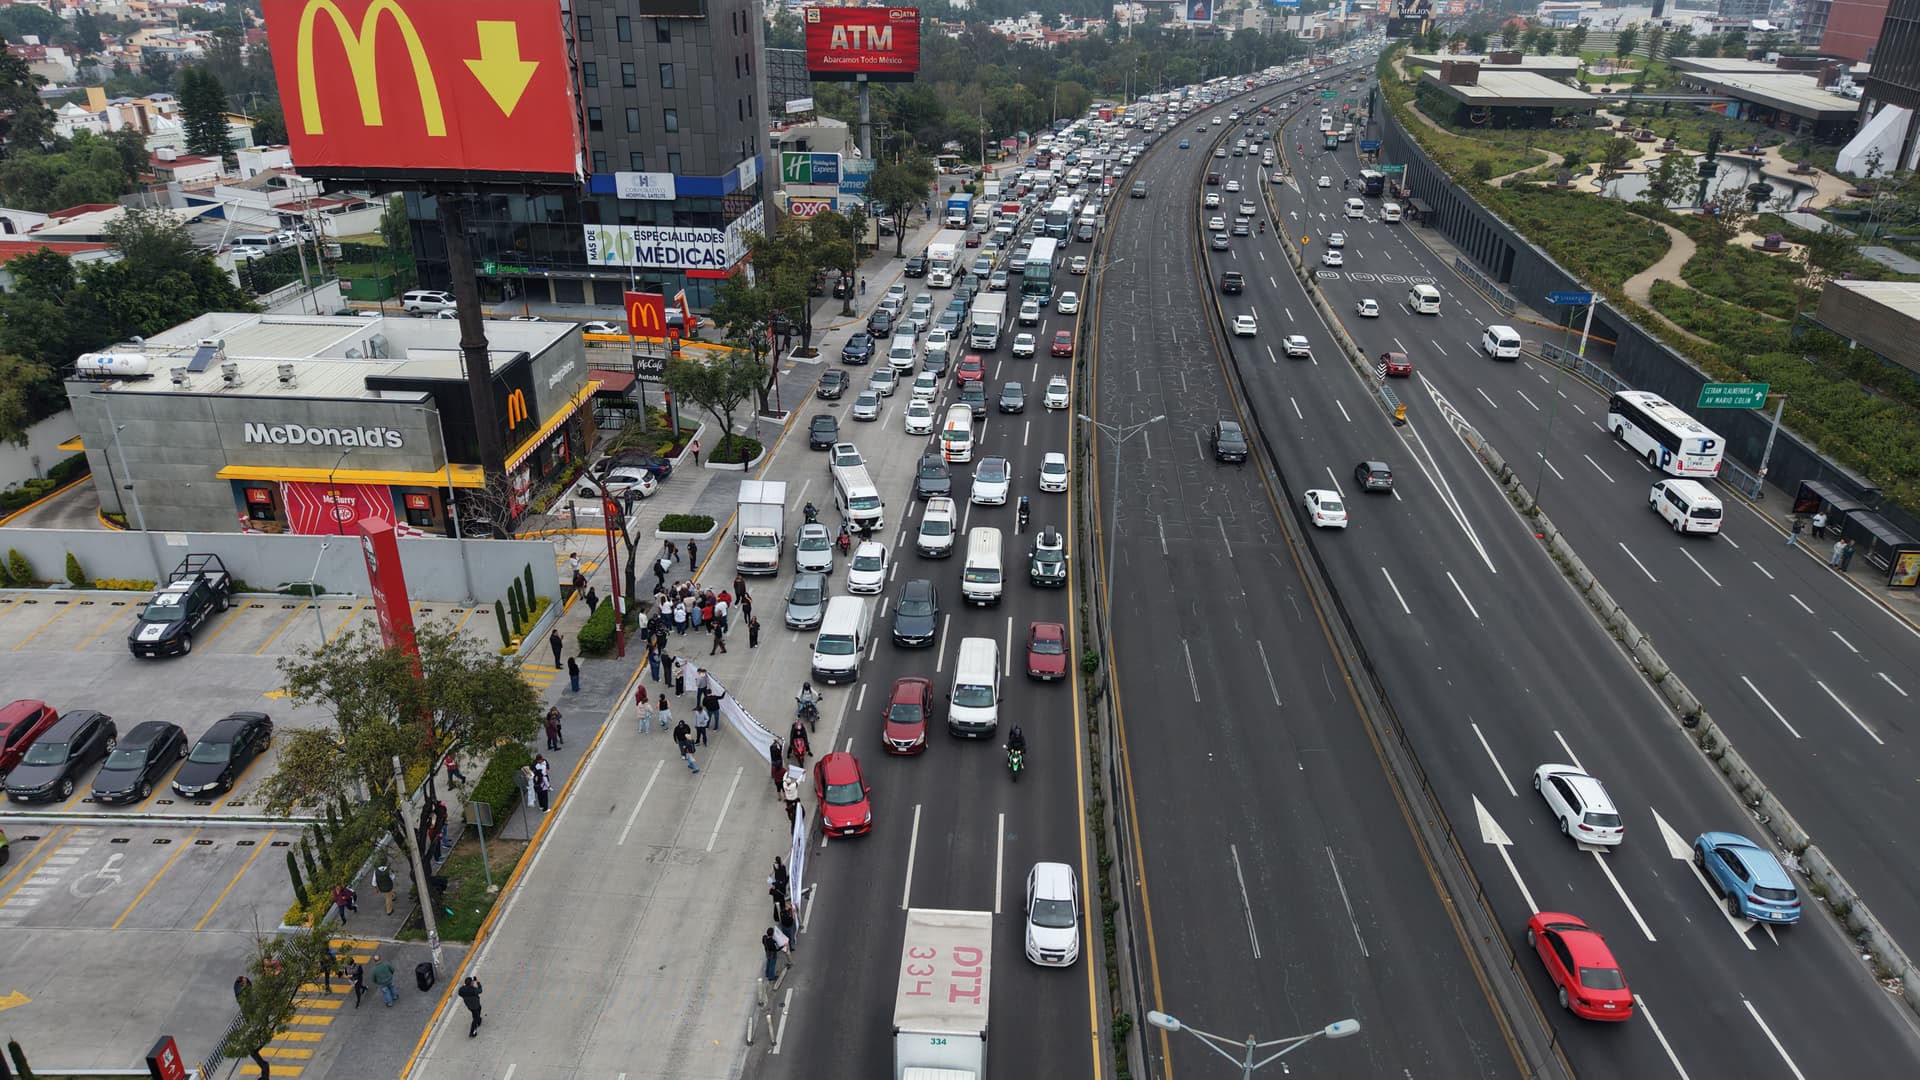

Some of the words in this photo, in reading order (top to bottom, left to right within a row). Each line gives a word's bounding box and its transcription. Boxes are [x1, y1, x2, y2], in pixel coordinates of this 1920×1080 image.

[830, 24, 893, 50] ATM
[861, 56, 878, 64] Todo
[879, 56, 902, 64] México
[813, 166, 837, 174] Express
[792, 202, 830, 217] OXXO
[587, 230, 596, 241] DE
[634, 230, 724, 243] ESPECIALIDADES
[595, 230, 635, 262] 20
[636, 242, 726, 266] MÉDICAS
[244, 422, 403, 448] McDonald's
[905, 946, 936, 996] 334
[930, 1037, 947, 1045] 334
